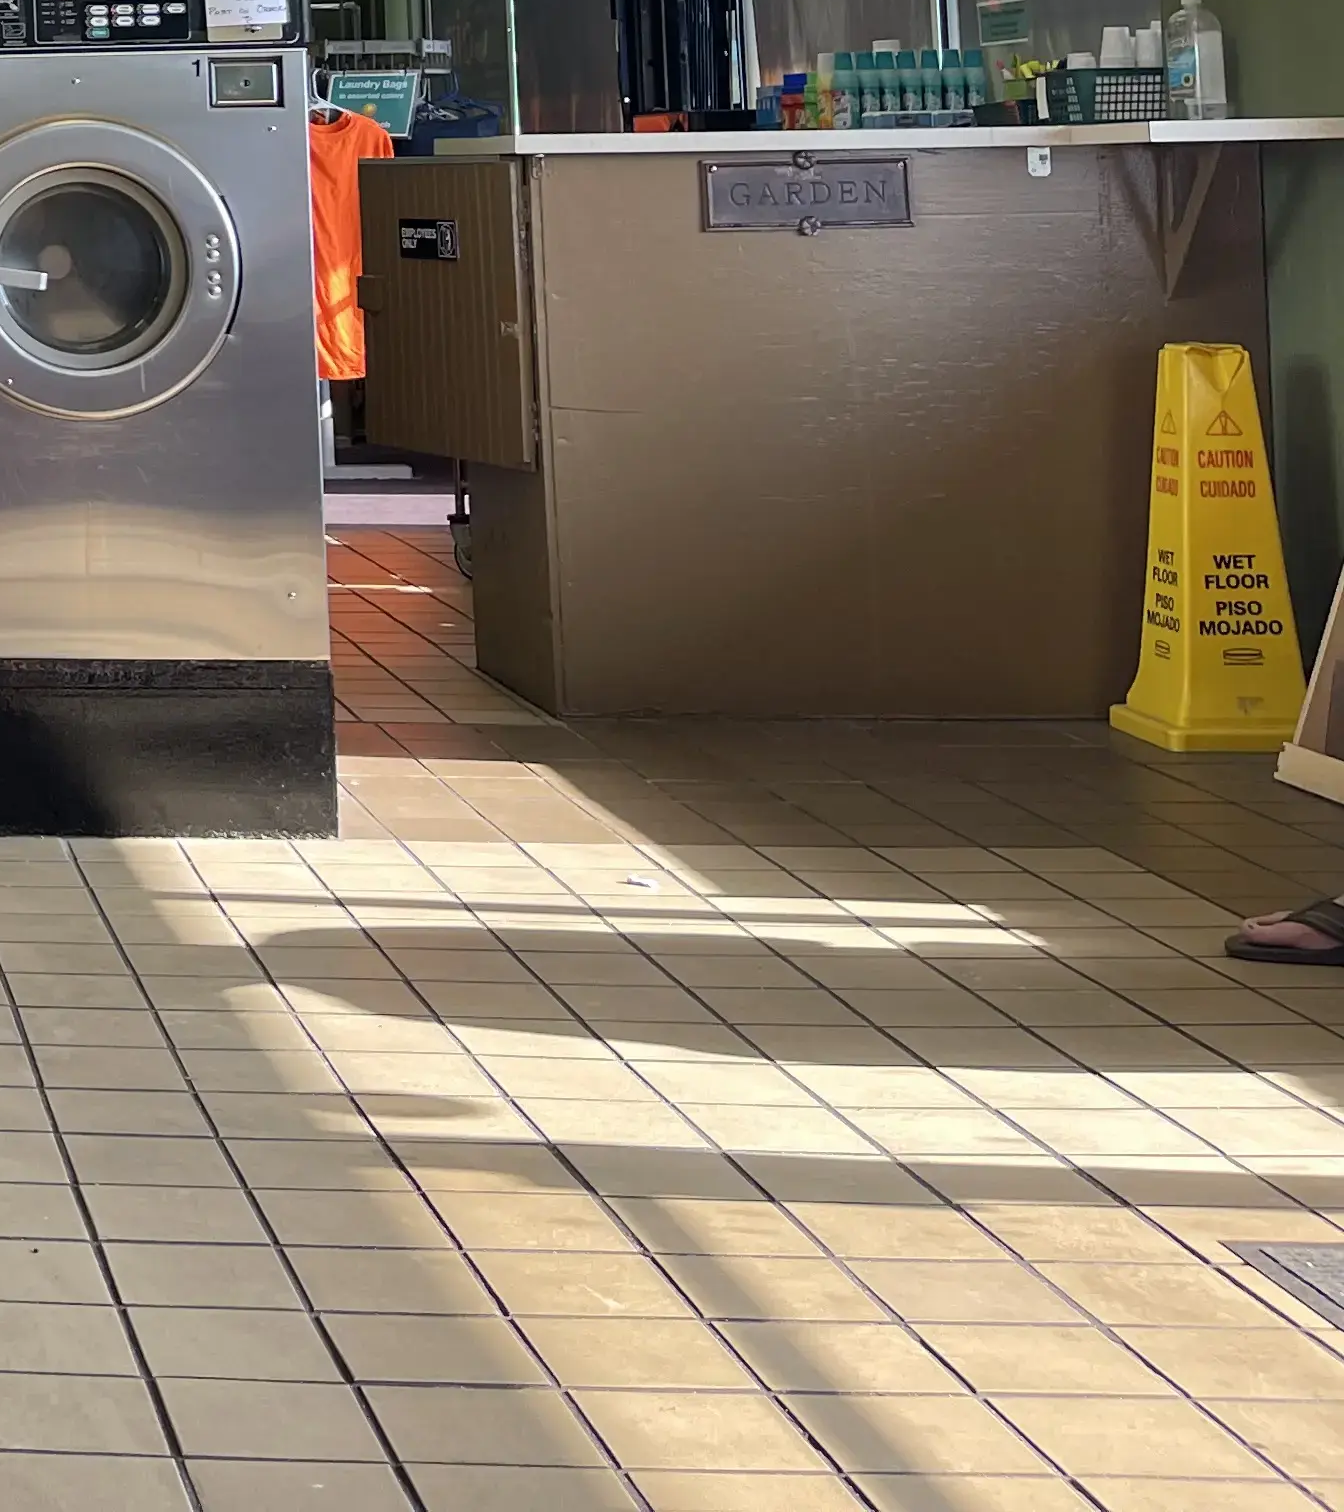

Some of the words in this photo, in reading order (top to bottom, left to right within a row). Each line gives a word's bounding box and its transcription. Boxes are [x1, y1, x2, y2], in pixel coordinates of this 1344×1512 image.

[192, 59, 200, 77] 1
[339, 80, 381, 90] Laundry
[382, 79, 408, 90] Bags
[729, 179, 888, 206] GARDEN
[1197, 450, 1253, 468] CAUTION
[1200, 480, 1256, 498] CUIDADO
[1157, 548, 1174, 566] WET
[1213, 554, 1256, 569] WET
[1152, 566, 1178, 586] FLOOR
[1204, 574, 1269, 589] FLOOR
[1155, 592, 1174, 611] PISO
[1216, 600, 1262, 615] PISO
[1147, 609, 1180, 633] MOJADO
[1199, 620, 1283, 635] MOJADO
